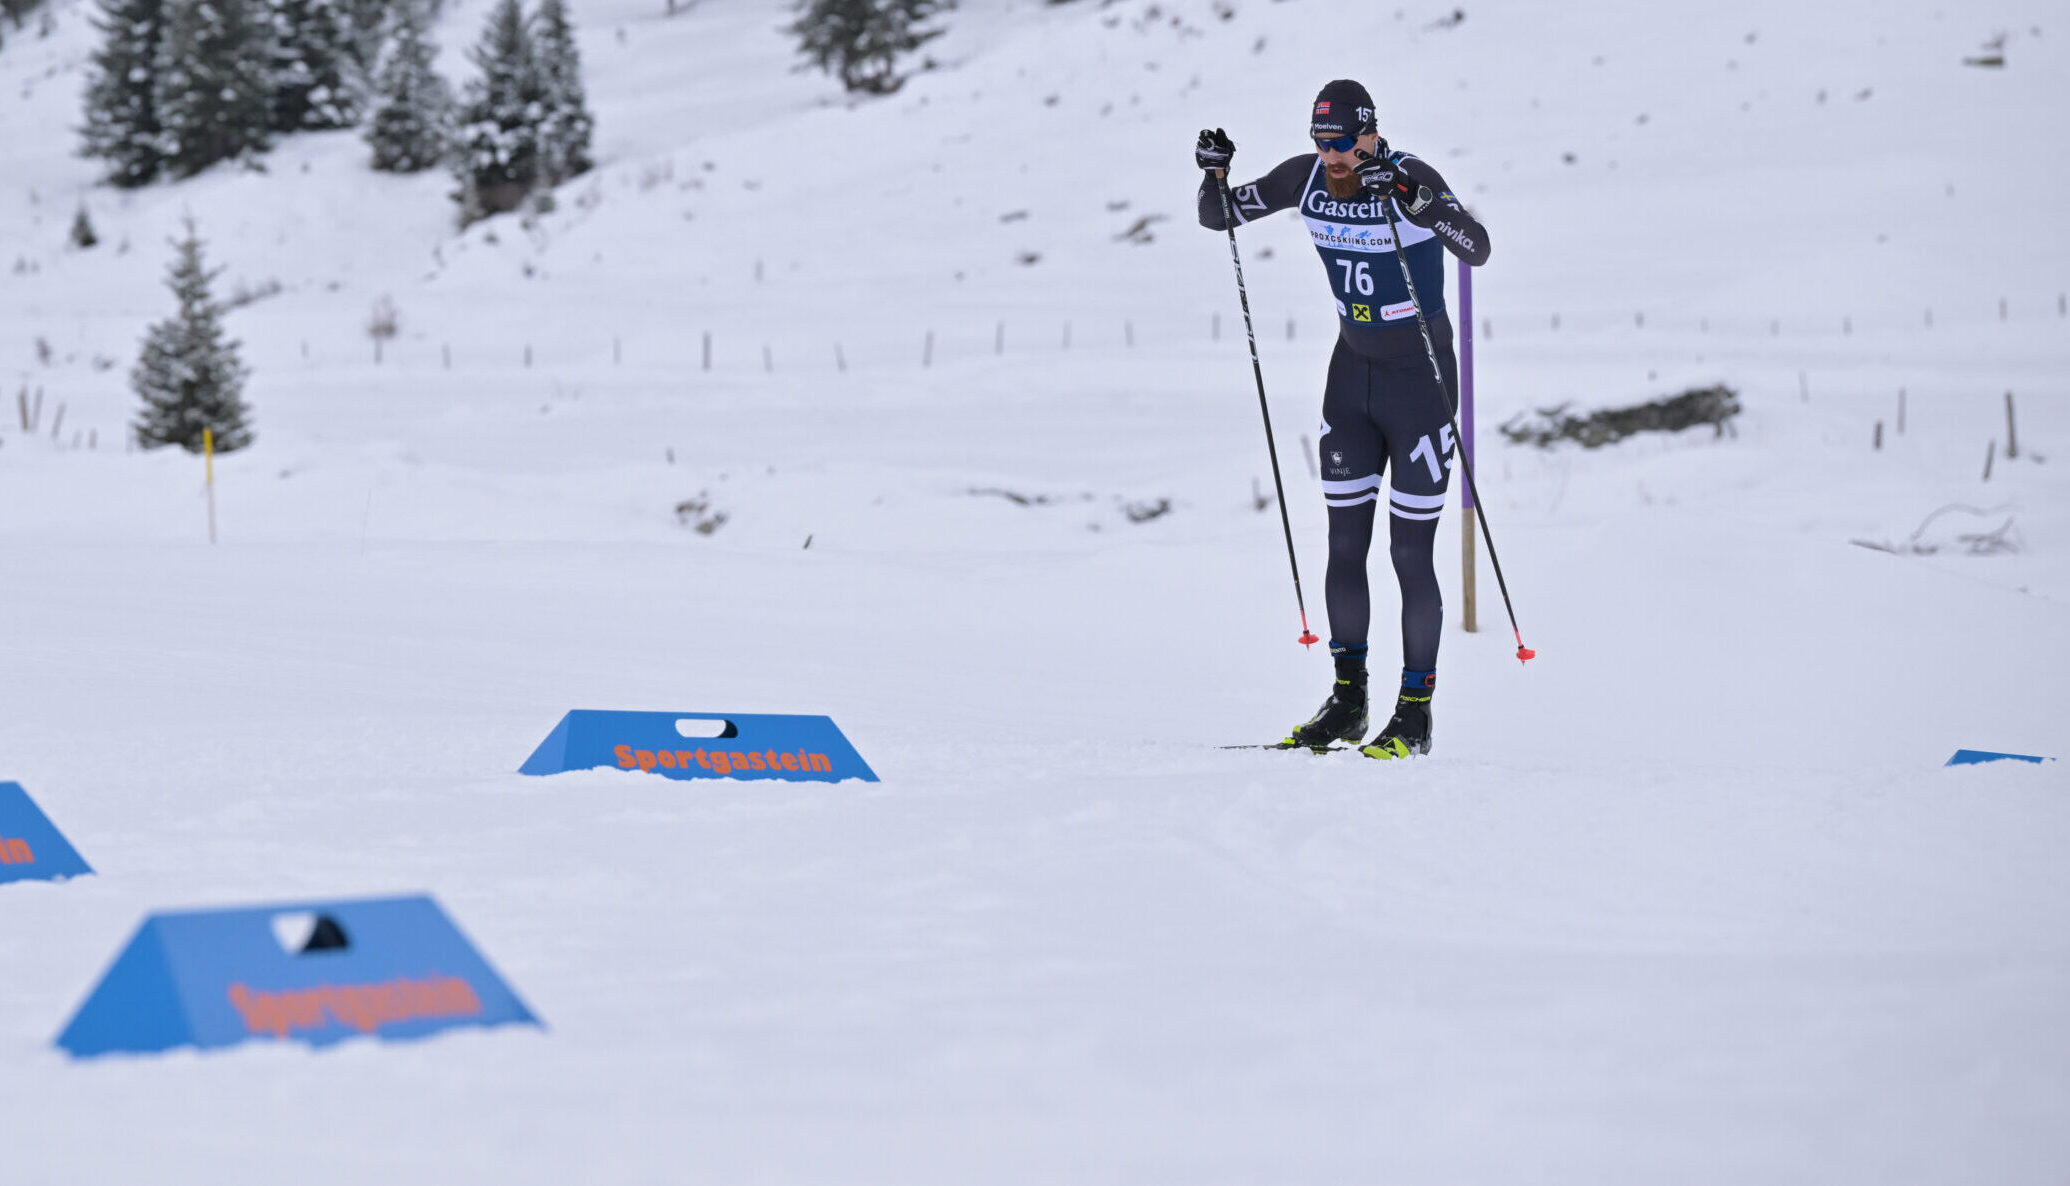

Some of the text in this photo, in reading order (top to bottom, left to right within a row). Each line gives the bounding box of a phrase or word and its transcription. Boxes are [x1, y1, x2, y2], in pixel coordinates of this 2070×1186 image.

[1314, 123, 1343, 131] Moelven
[1336, 258, 1375, 296] 76
[613, 744, 832, 774] Sportgastein
